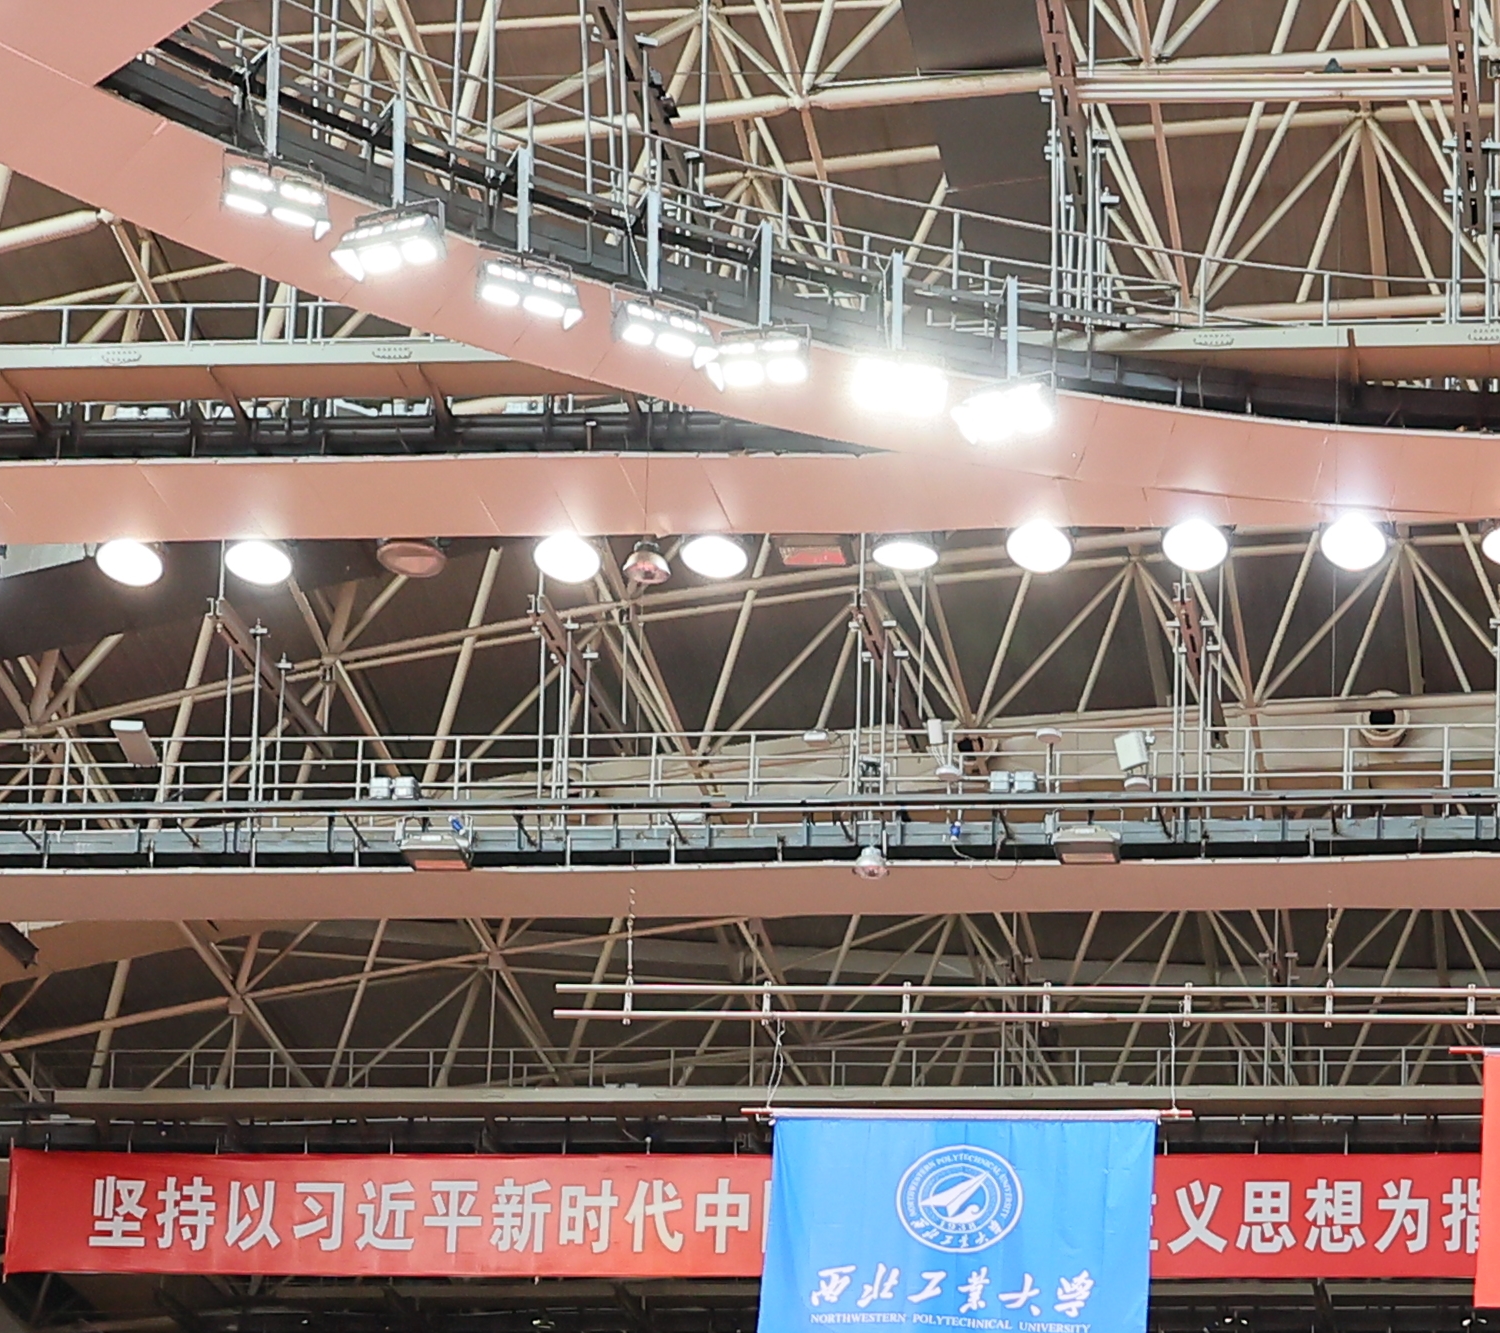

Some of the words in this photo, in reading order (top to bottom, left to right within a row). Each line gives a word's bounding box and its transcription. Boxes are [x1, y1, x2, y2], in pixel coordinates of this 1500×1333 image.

[89, 1176, 771, 1254] 坚持以习近平新时代中
[1151, 1177, 1481, 1254] 义思想为指
[939, 1221, 978, 1231] 1938
[810, 1312, 907, 1325] NORTHWESTERN
[912, 1313, 1012, 1330] POLYTECHNICAL
